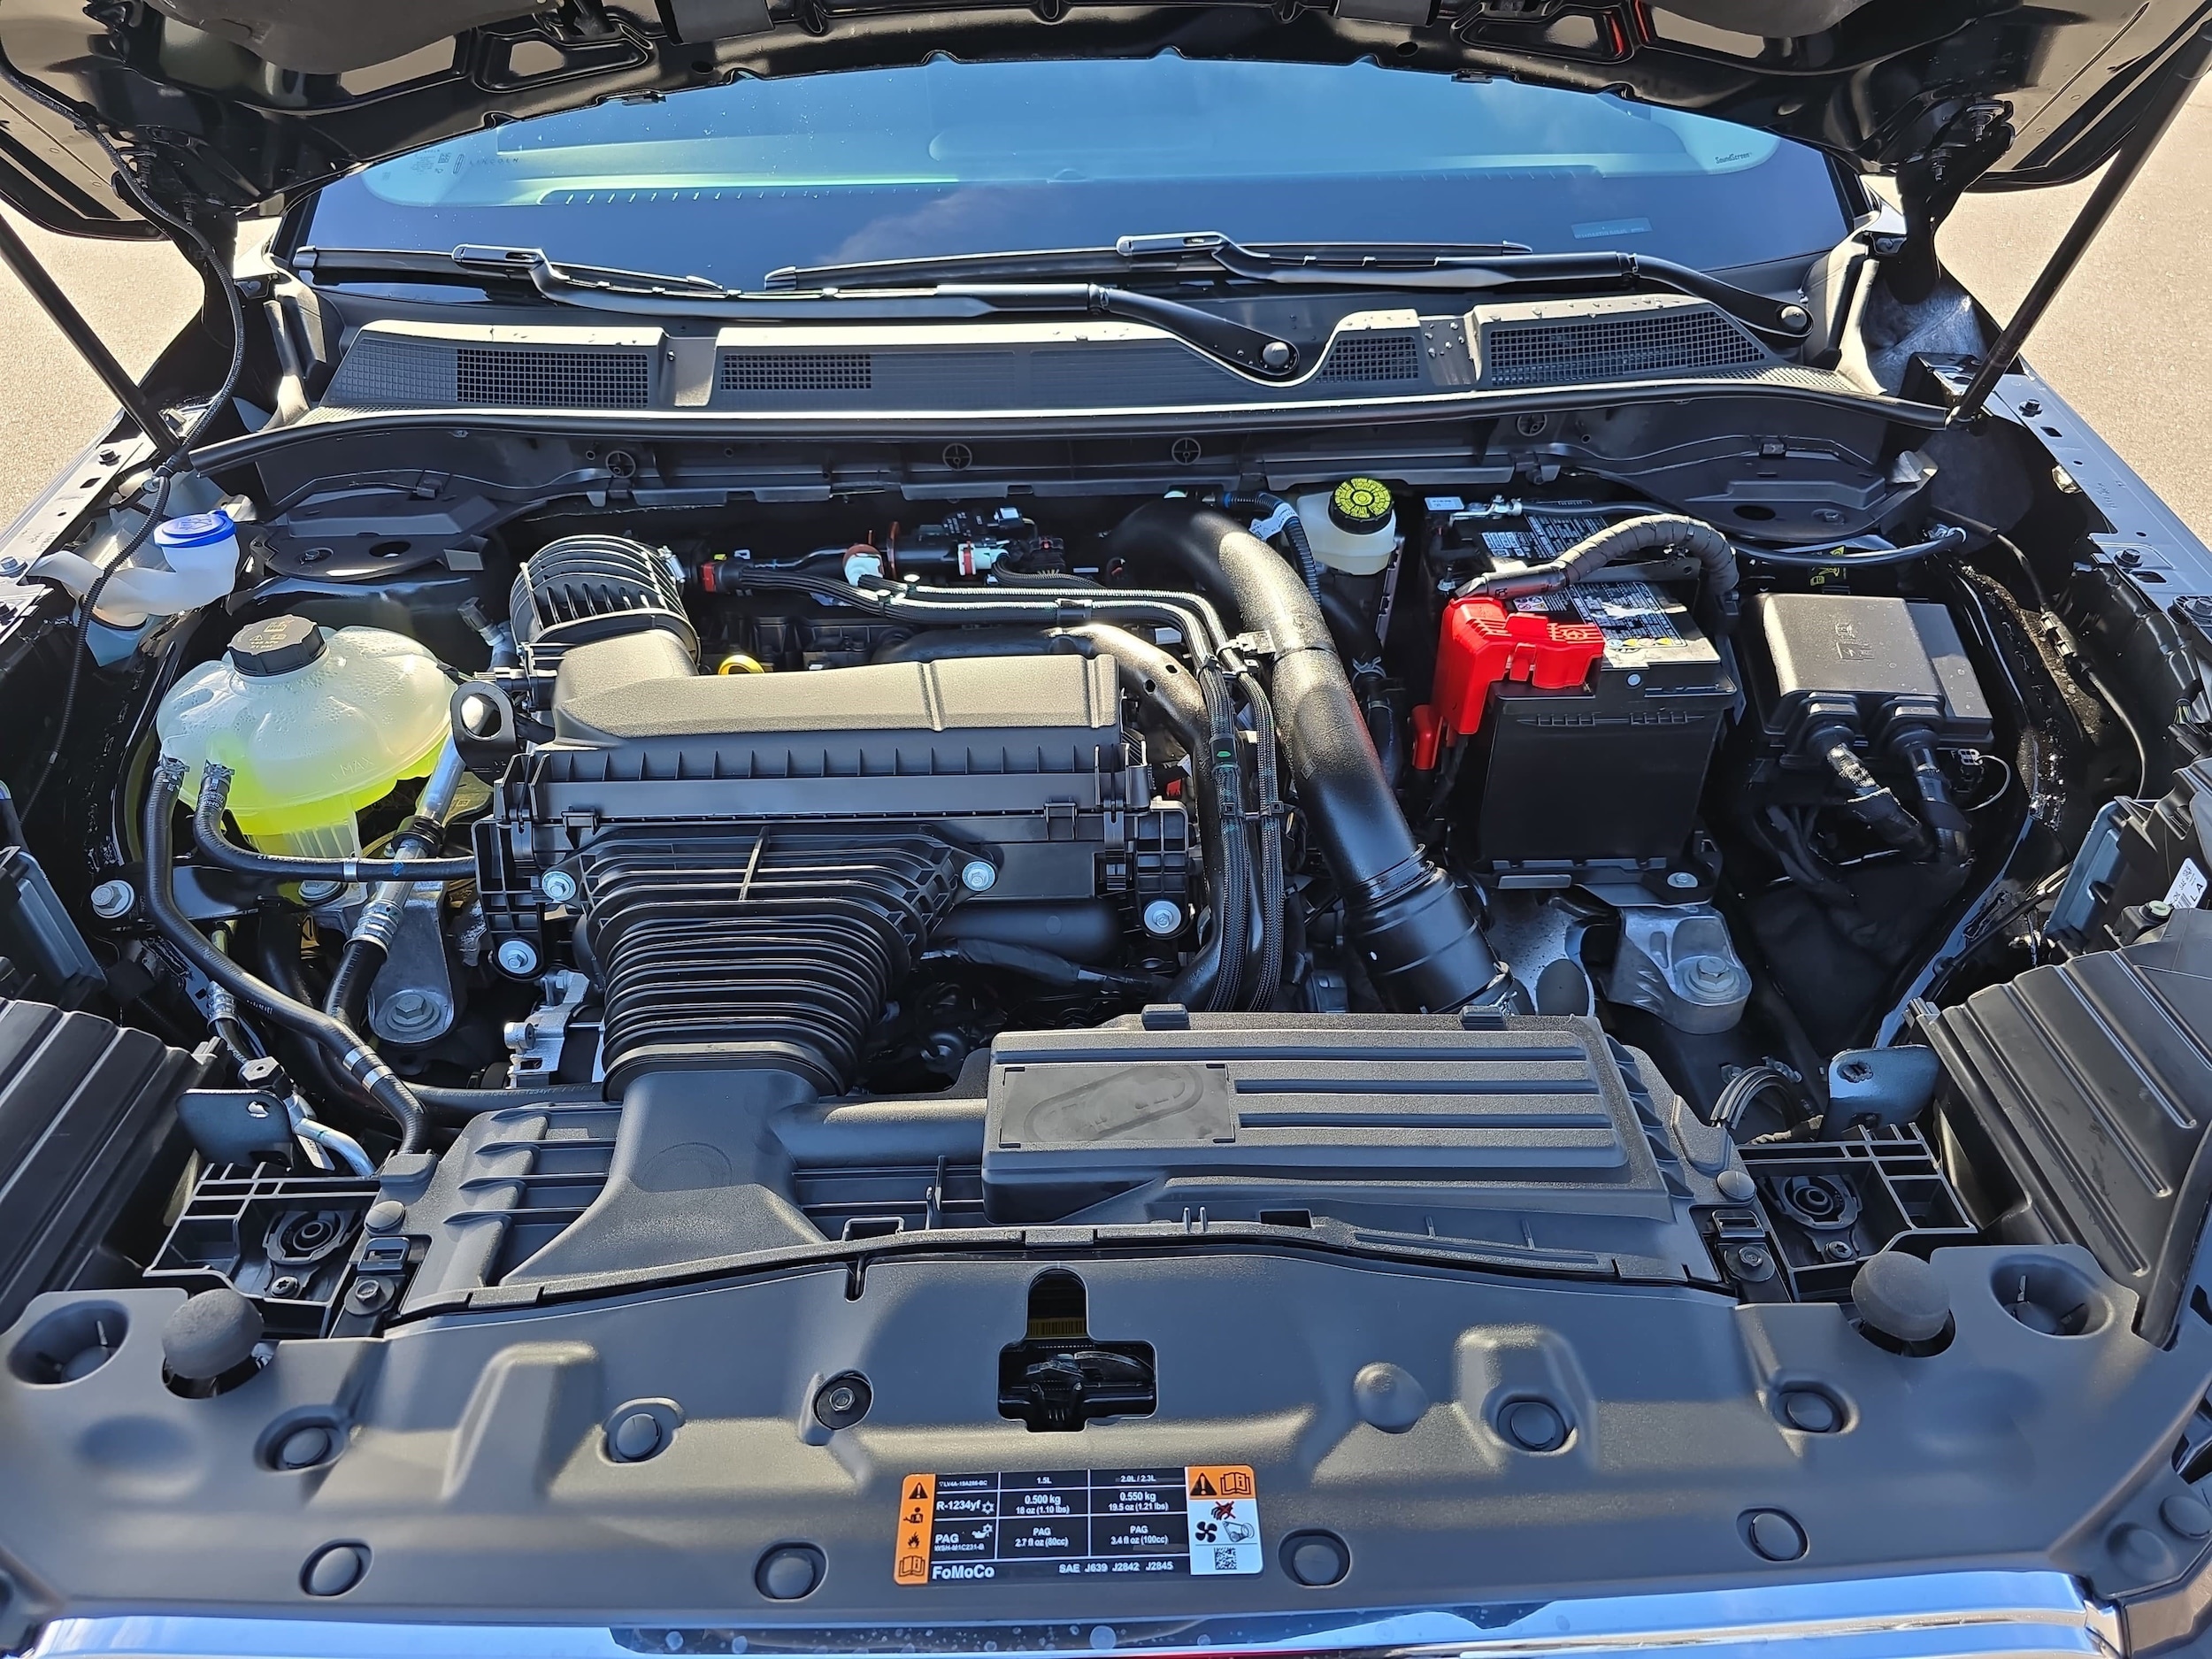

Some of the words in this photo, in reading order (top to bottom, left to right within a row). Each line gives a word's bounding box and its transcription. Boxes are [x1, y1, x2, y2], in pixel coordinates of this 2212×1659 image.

[340, 757, 374, 777] MAX
[1036, 1476, 1052, 1485] 1.5L
[1024, 1494, 1048, 1505] 0.500
[1049, 1494, 1061, 1506] kg
[1119, 1492, 1143, 1502] 0.550
[1144, 1492, 1156, 1502] kg
[936, 1499, 981, 1511] R-1234yf
[1015, 1506, 1025, 1515] 18
[1036, 1505, 1055, 1515] (1.10
[1055, 1504, 1071, 1515] lbs)
[1108, 1503, 1125, 1512] 19.5
[1134, 1502, 1153, 1512] (1.21
[1153, 1502, 1169, 1512] lbs)
[1033, 1527, 1052, 1536] PAG
[1130, 1525, 1148, 1534] PAG
[934, 1533, 960, 1544] PAG
[1014, 1537, 1027, 1548] 2.7
[1045, 1536, 1069, 1548] (80cc)
[1110, 1535, 1123, 1545] 3.4
[1141, 1534, 1169, 1545] (100cc)
[932, 1564, 995, 1580] FoMoCo
[1058, 1563, 1081, 1573] SAE
[1084, 1563, 1108, 1573] J639
[1111, 1562, 1140, 1571] J2842
[1145, 1562, 1174, 1571] J2845
